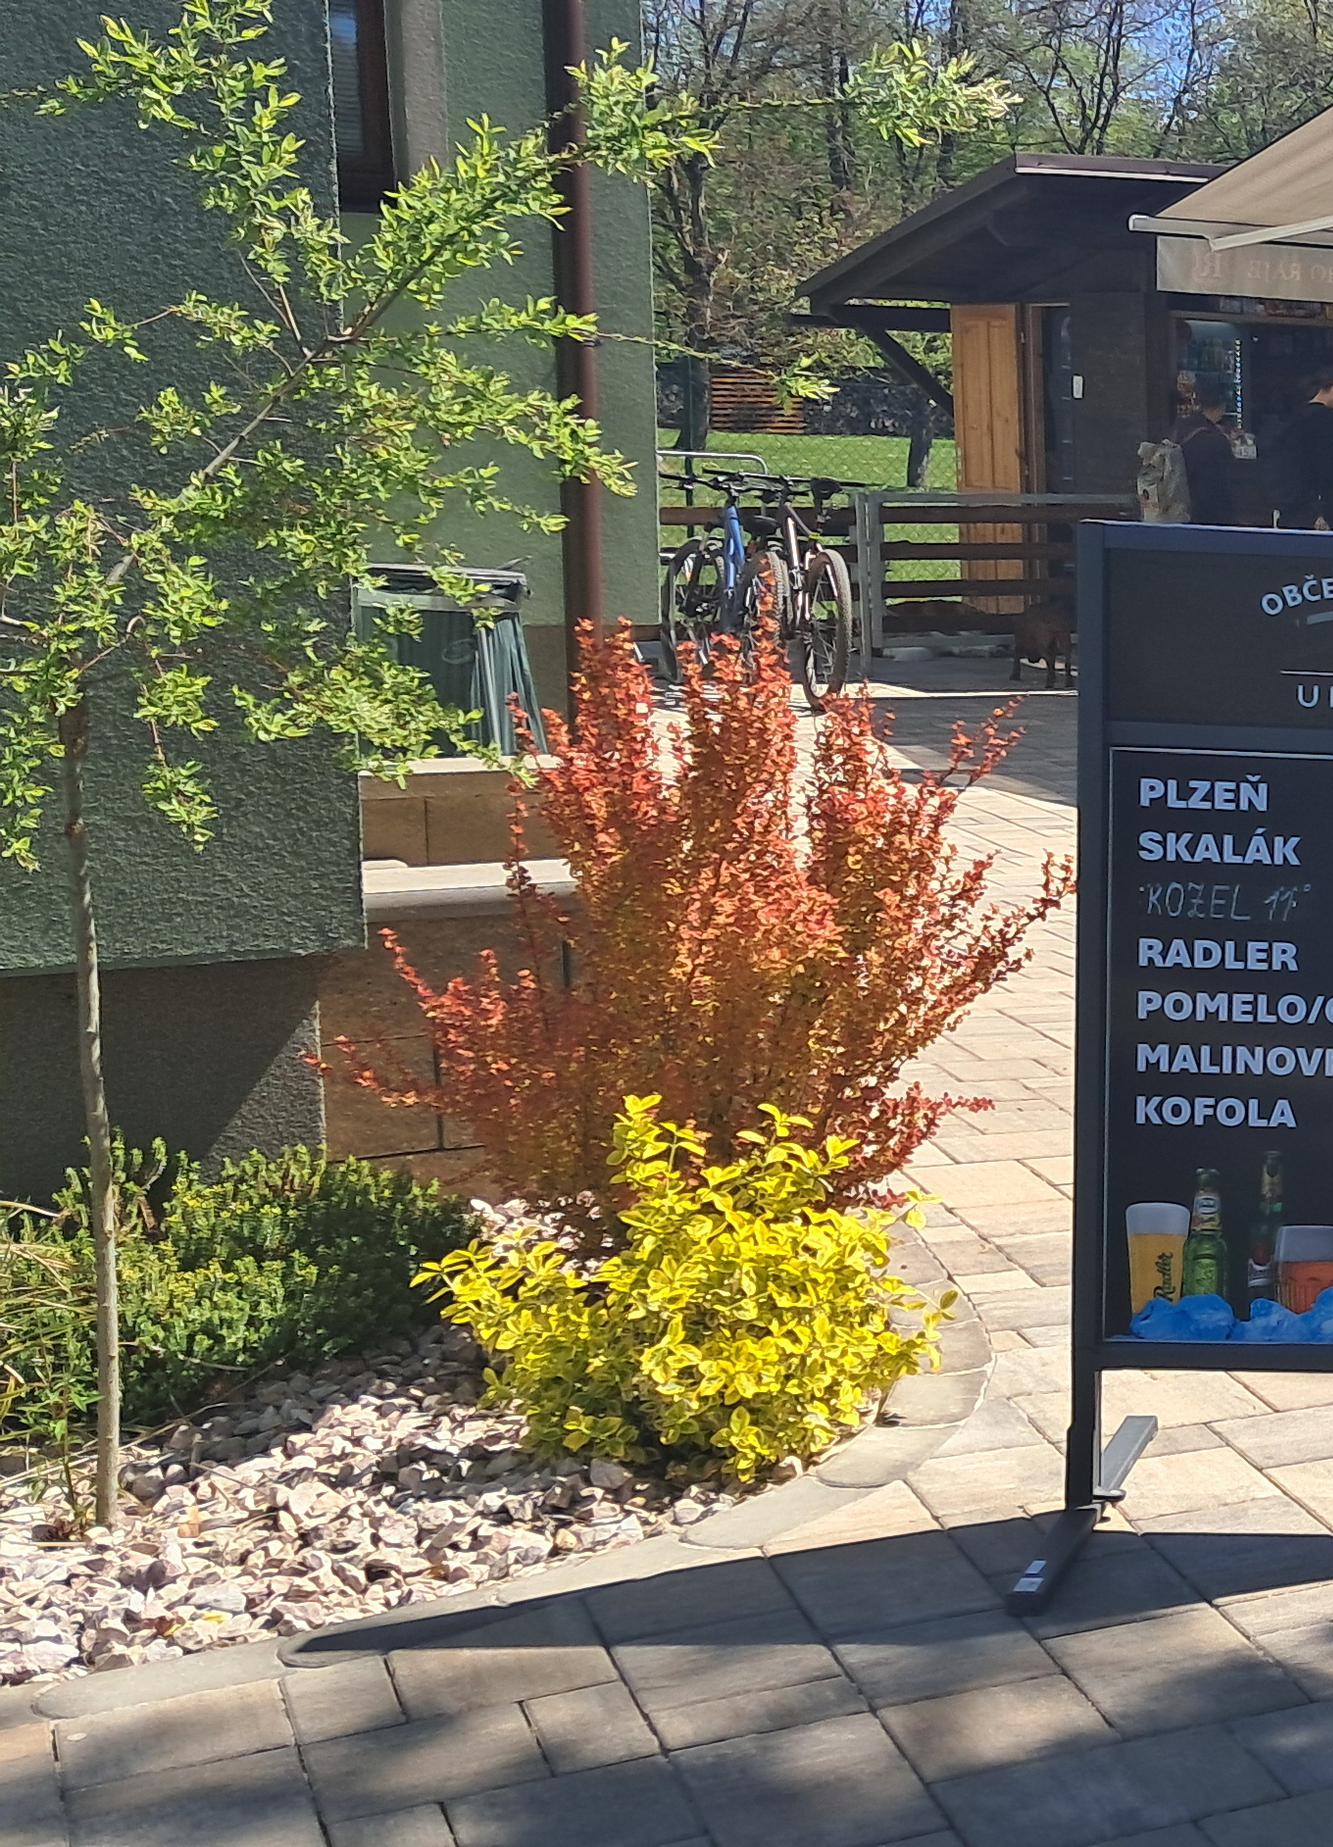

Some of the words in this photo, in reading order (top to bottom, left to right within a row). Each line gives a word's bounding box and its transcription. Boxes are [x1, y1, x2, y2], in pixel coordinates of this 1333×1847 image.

[1297, 684, 1320, 708] U
[1139, 774, 1269, 812] PLZEŇ
[1137, 827, 1302, 866] SKALÁK
[1147, 881, 1251, 921] KOZEL
[1137, 937, 1299, 972] RADLER
[1135, 1095, 1297, 1128] KOFOLA
[1153, 1251, 1177, 1302] Radler
